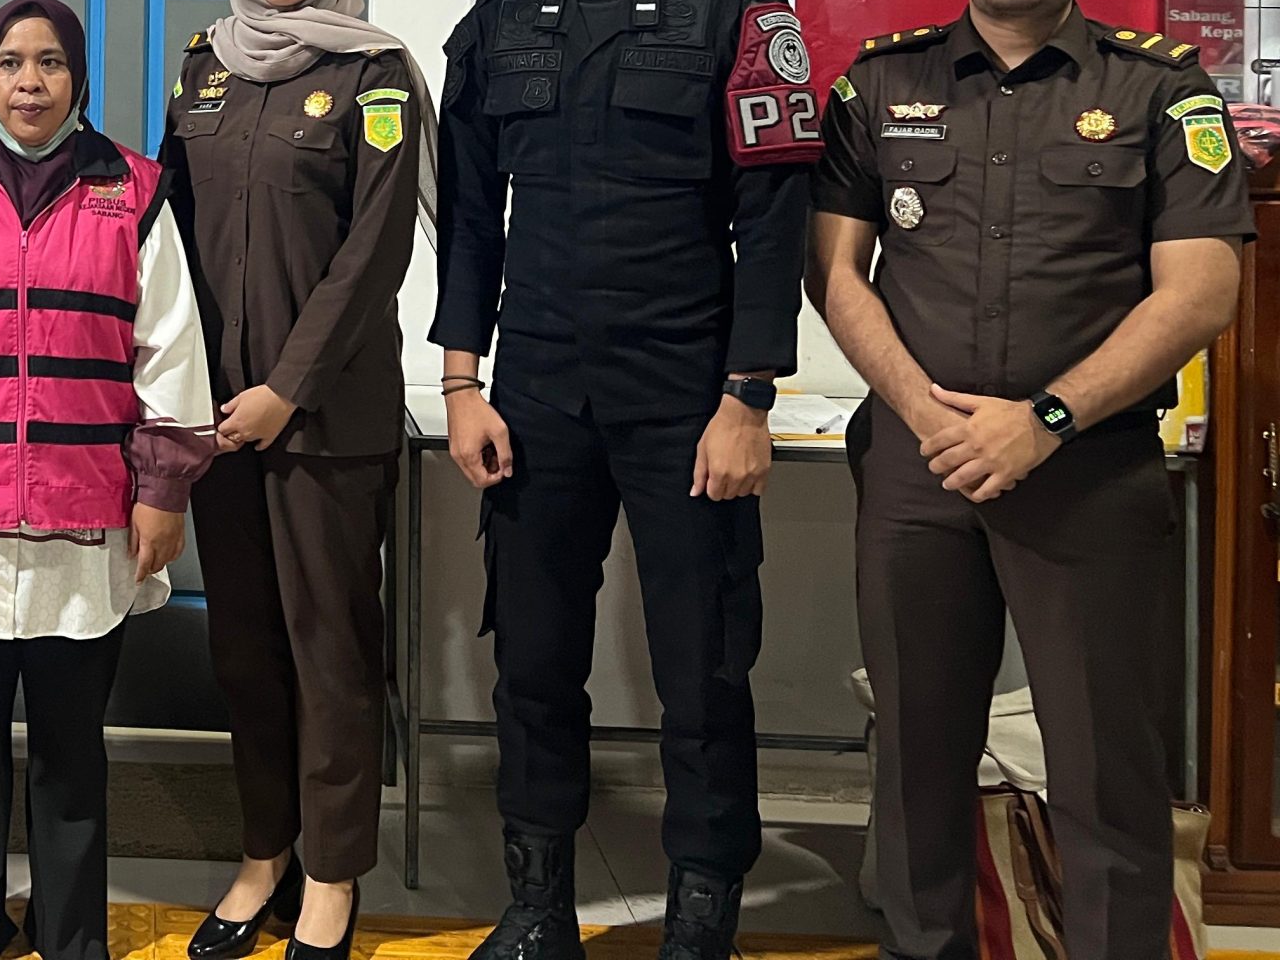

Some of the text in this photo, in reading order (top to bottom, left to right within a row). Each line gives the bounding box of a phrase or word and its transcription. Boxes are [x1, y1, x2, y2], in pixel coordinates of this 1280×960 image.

[1168, 9, 1236, 25] Sabang,
[1200, 25, 1244, 41] Kepa
[737, 91, 820, 147] P2
